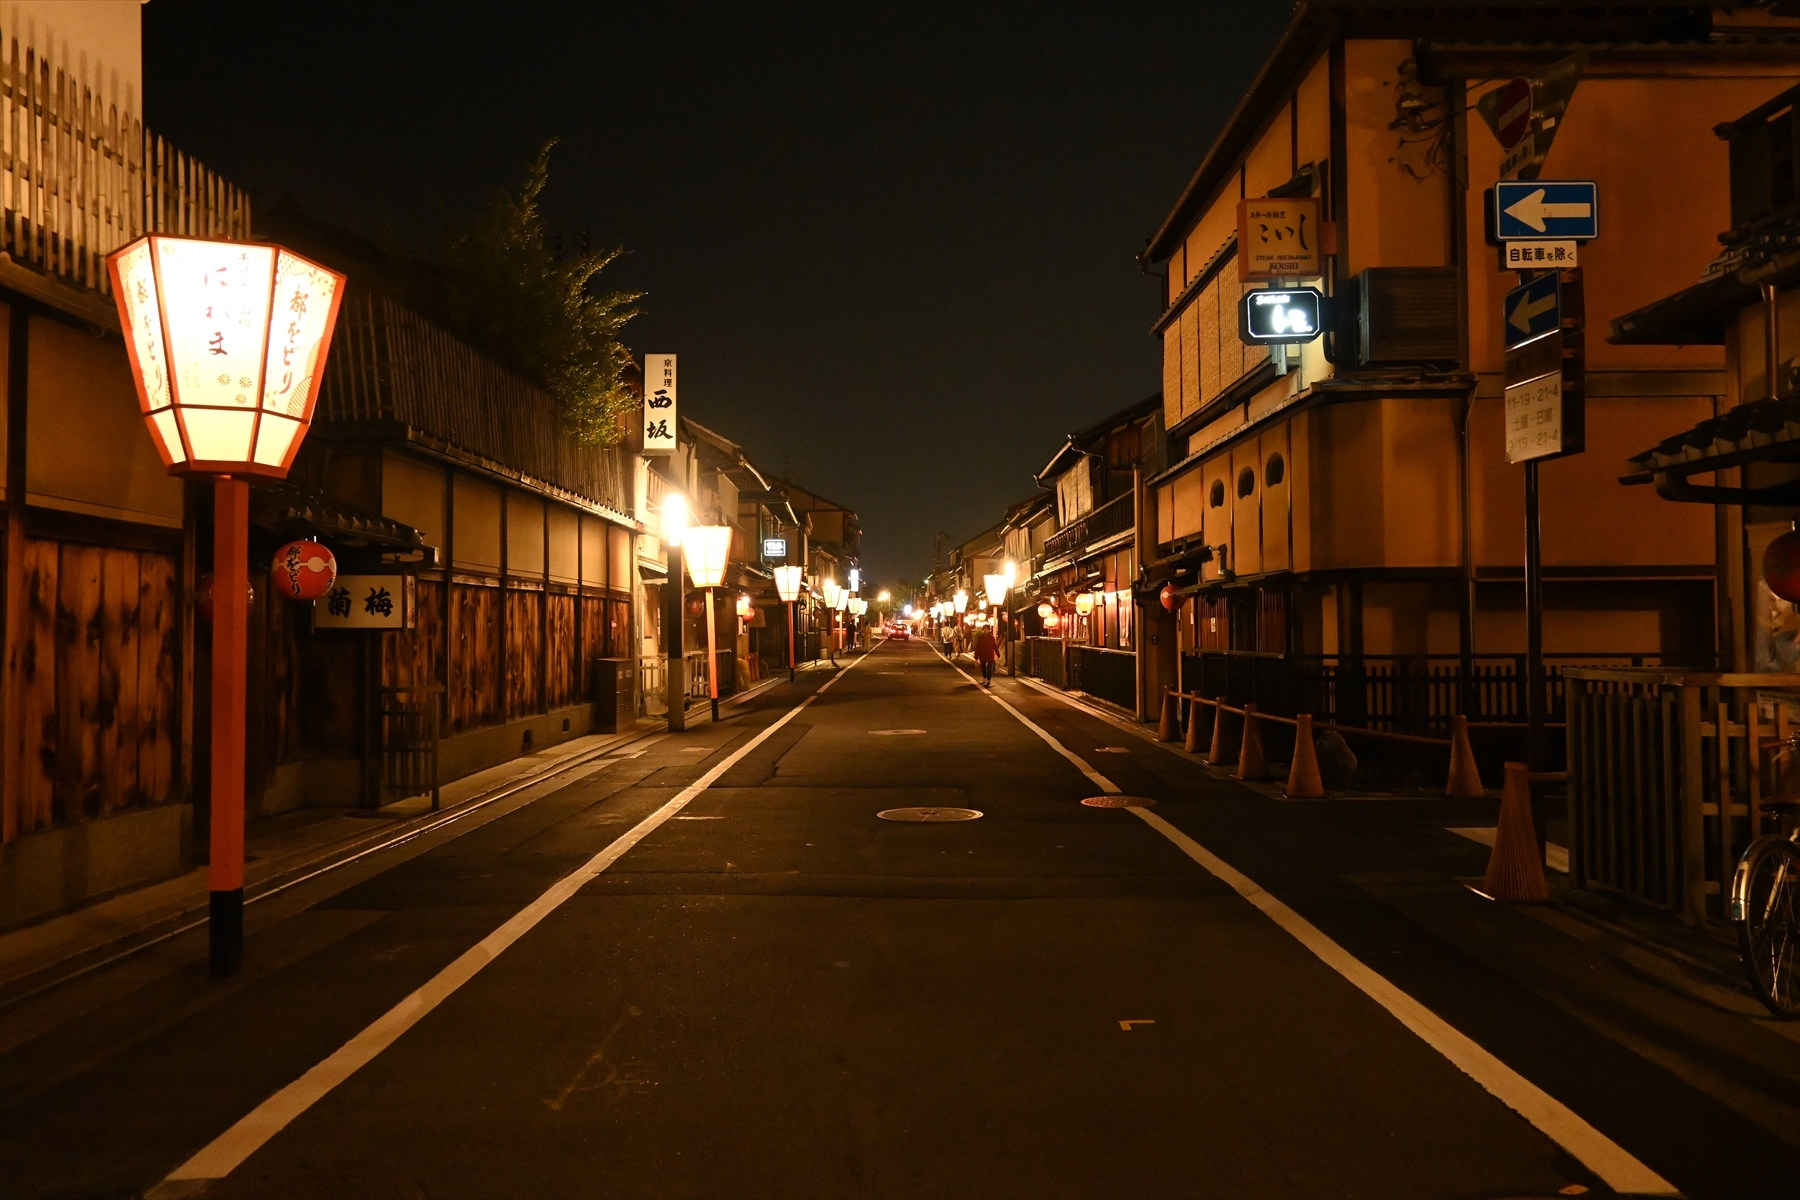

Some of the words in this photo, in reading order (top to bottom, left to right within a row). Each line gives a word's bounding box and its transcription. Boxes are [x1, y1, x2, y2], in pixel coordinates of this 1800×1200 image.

[1250, 211, 1287, 219] ステーキ割烹
[1259, 213, 1309, 251] こいし
[1269, 262, 1299, 270] KOISHI
[1510, 247, 1574, 262] 自転車を除く
[278, 285, 309, 395] 都をどり
[663, 358, 673, 388] 京料理
[646, 389, 674, 440] 西坂
[286, 545, 302, 596] 都をどり
[327, 586, 394, 618] 菊梅
